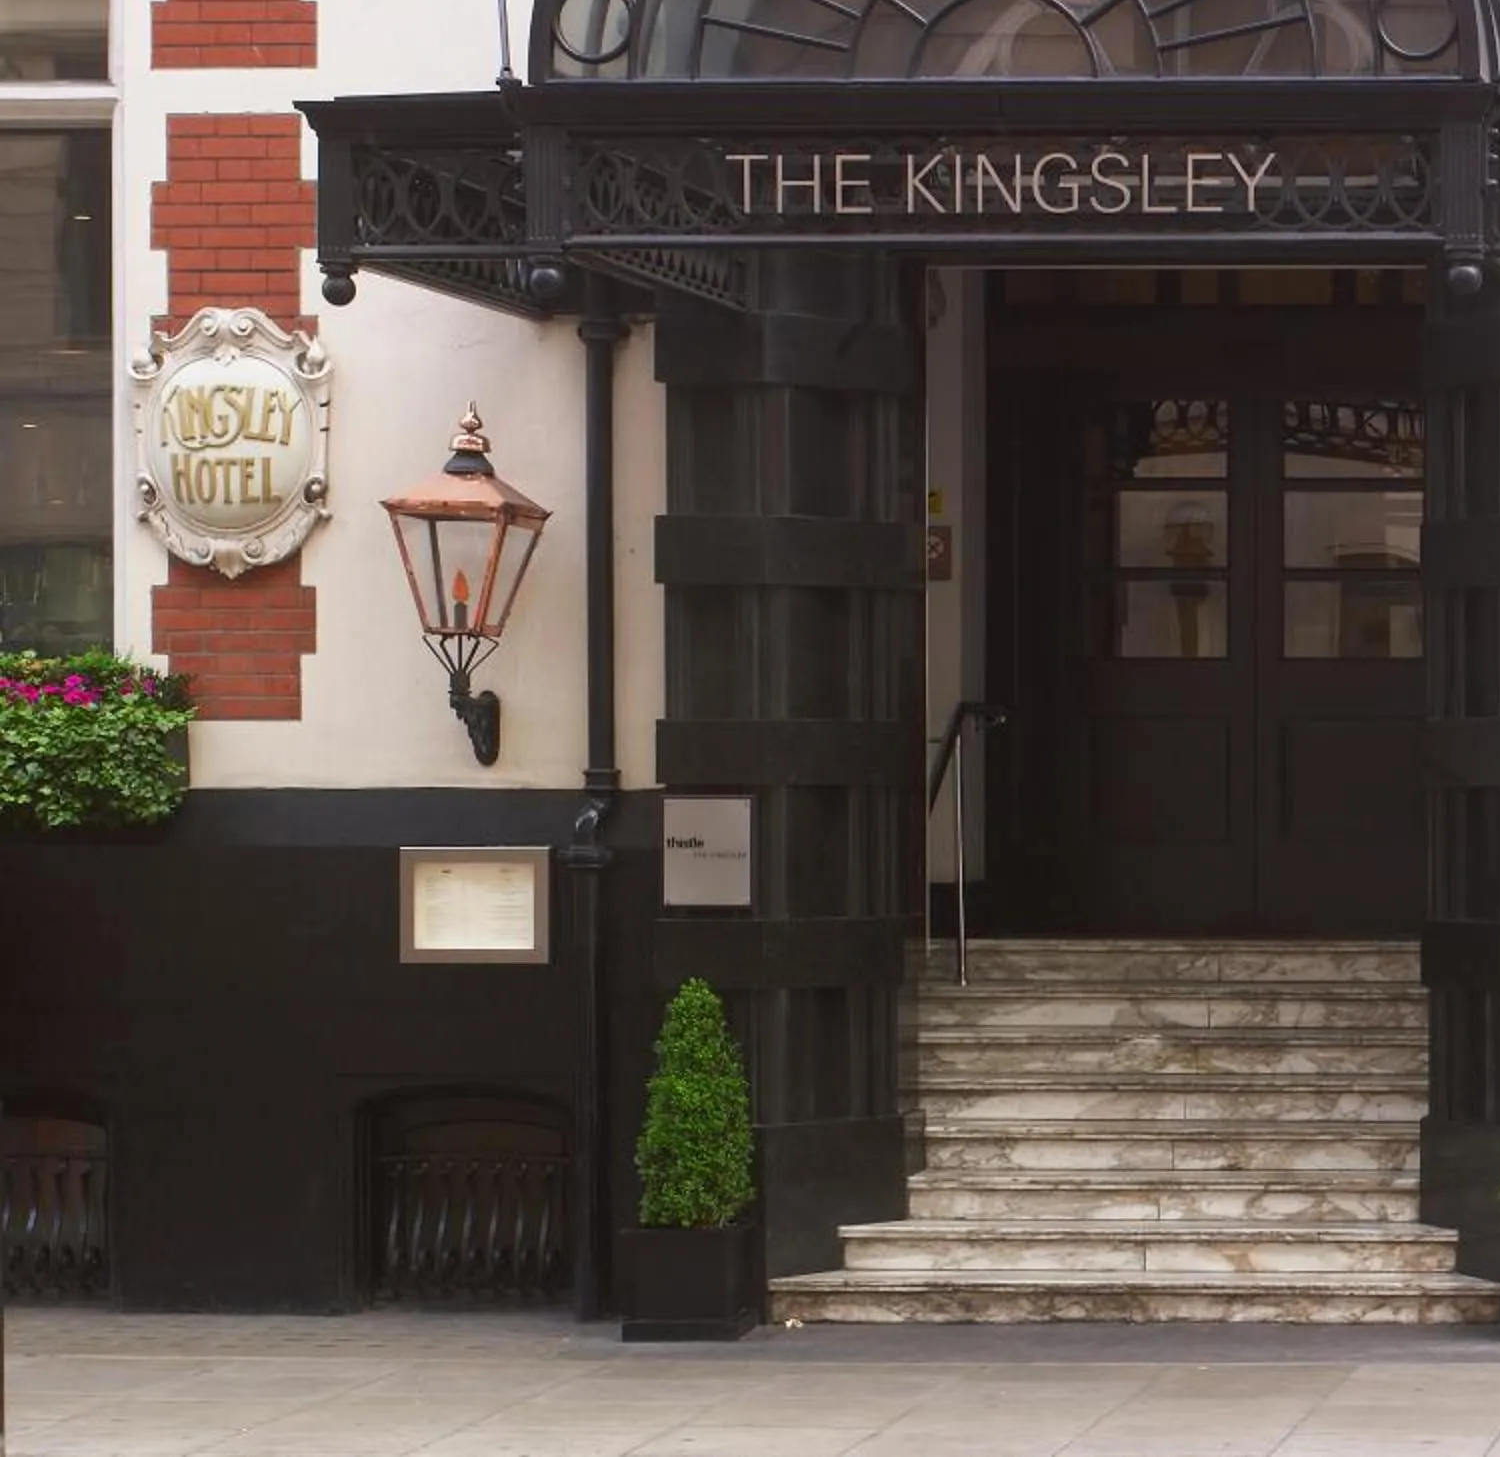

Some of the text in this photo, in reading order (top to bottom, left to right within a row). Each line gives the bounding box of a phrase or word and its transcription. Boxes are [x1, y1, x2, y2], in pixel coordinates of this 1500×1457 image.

[726, 152, 1276, 214] THE KINGSLEY
[161, 384, 302, 451] KINGSLEY
[171, 453, 283, 505] HOTEL
